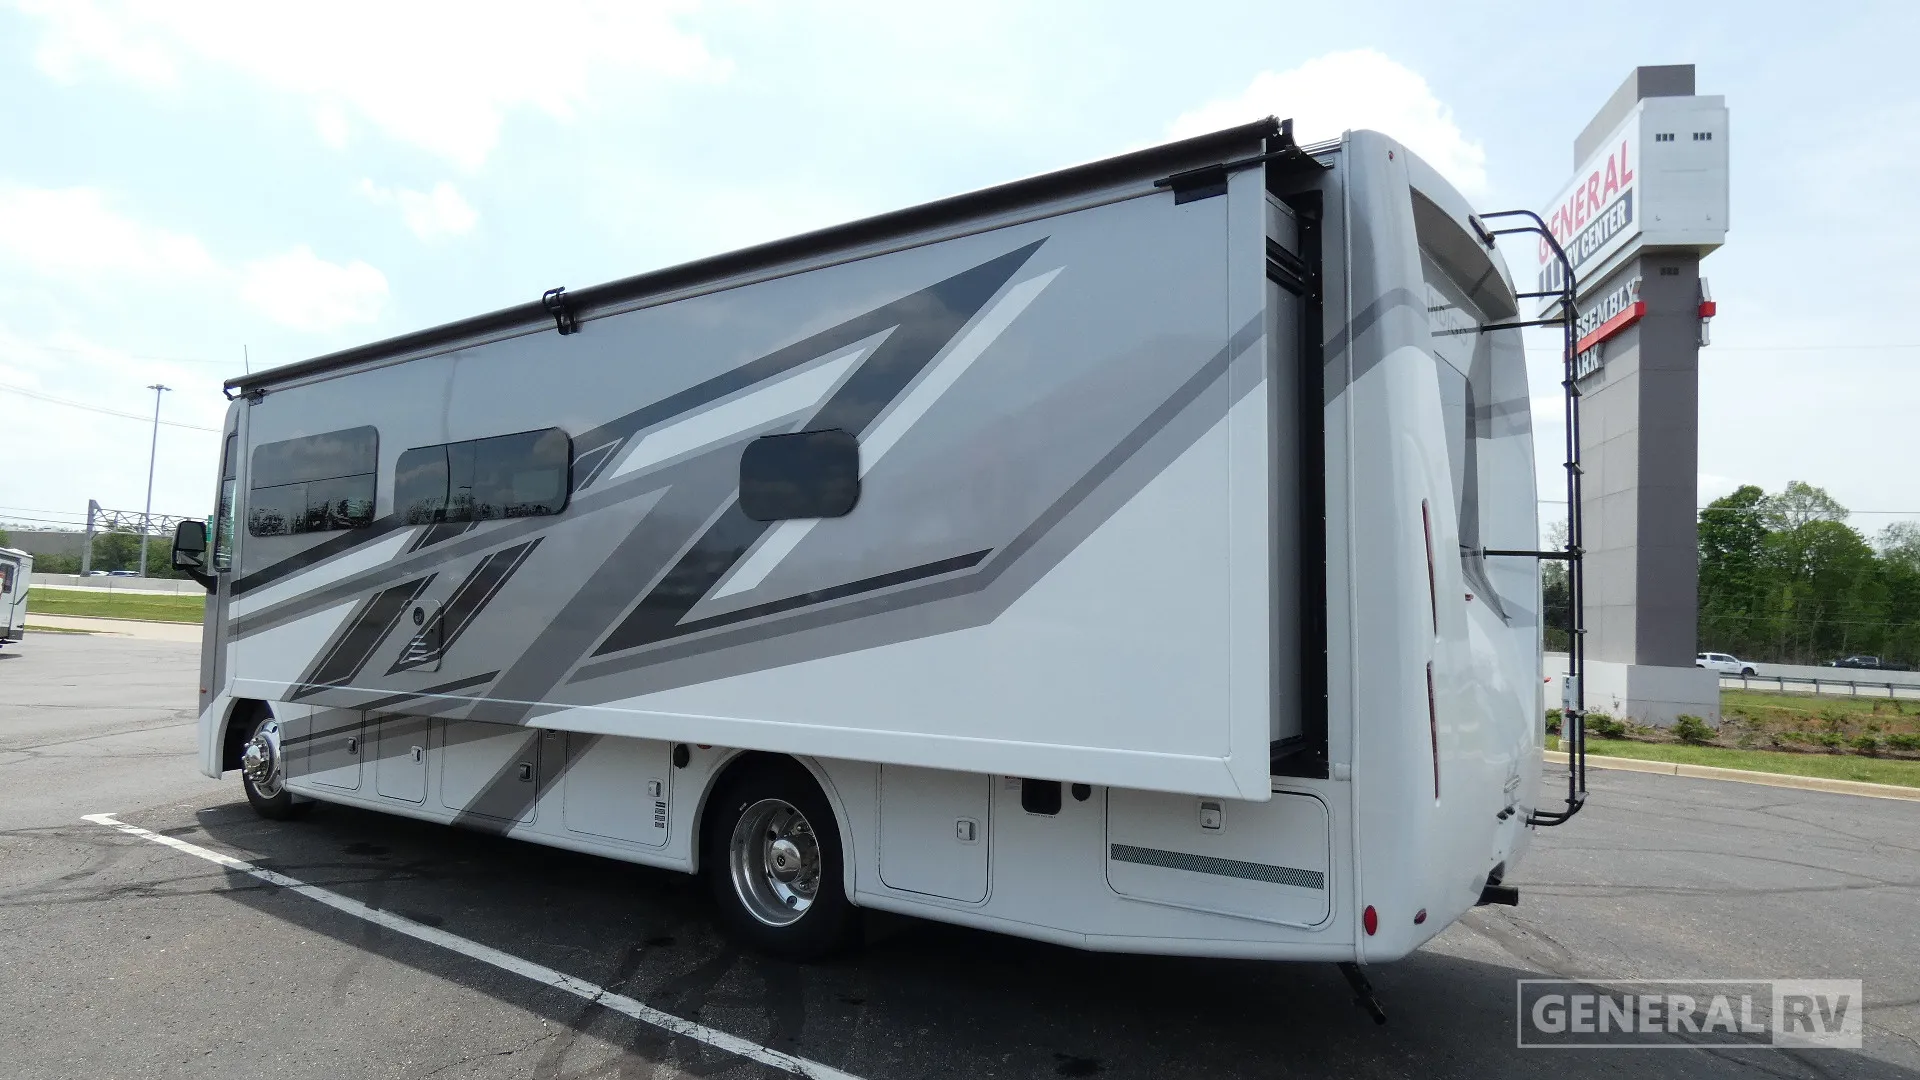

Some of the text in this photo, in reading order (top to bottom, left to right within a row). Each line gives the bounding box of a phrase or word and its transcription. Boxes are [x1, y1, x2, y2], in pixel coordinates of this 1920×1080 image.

[1538, 140, 1633, 266] GENERAL
[1581, 199, 1626, 259] CENTER
[1572, 276, 1641, 343] SSEMBLY
[1572, 342, 1600, 380] ARK
